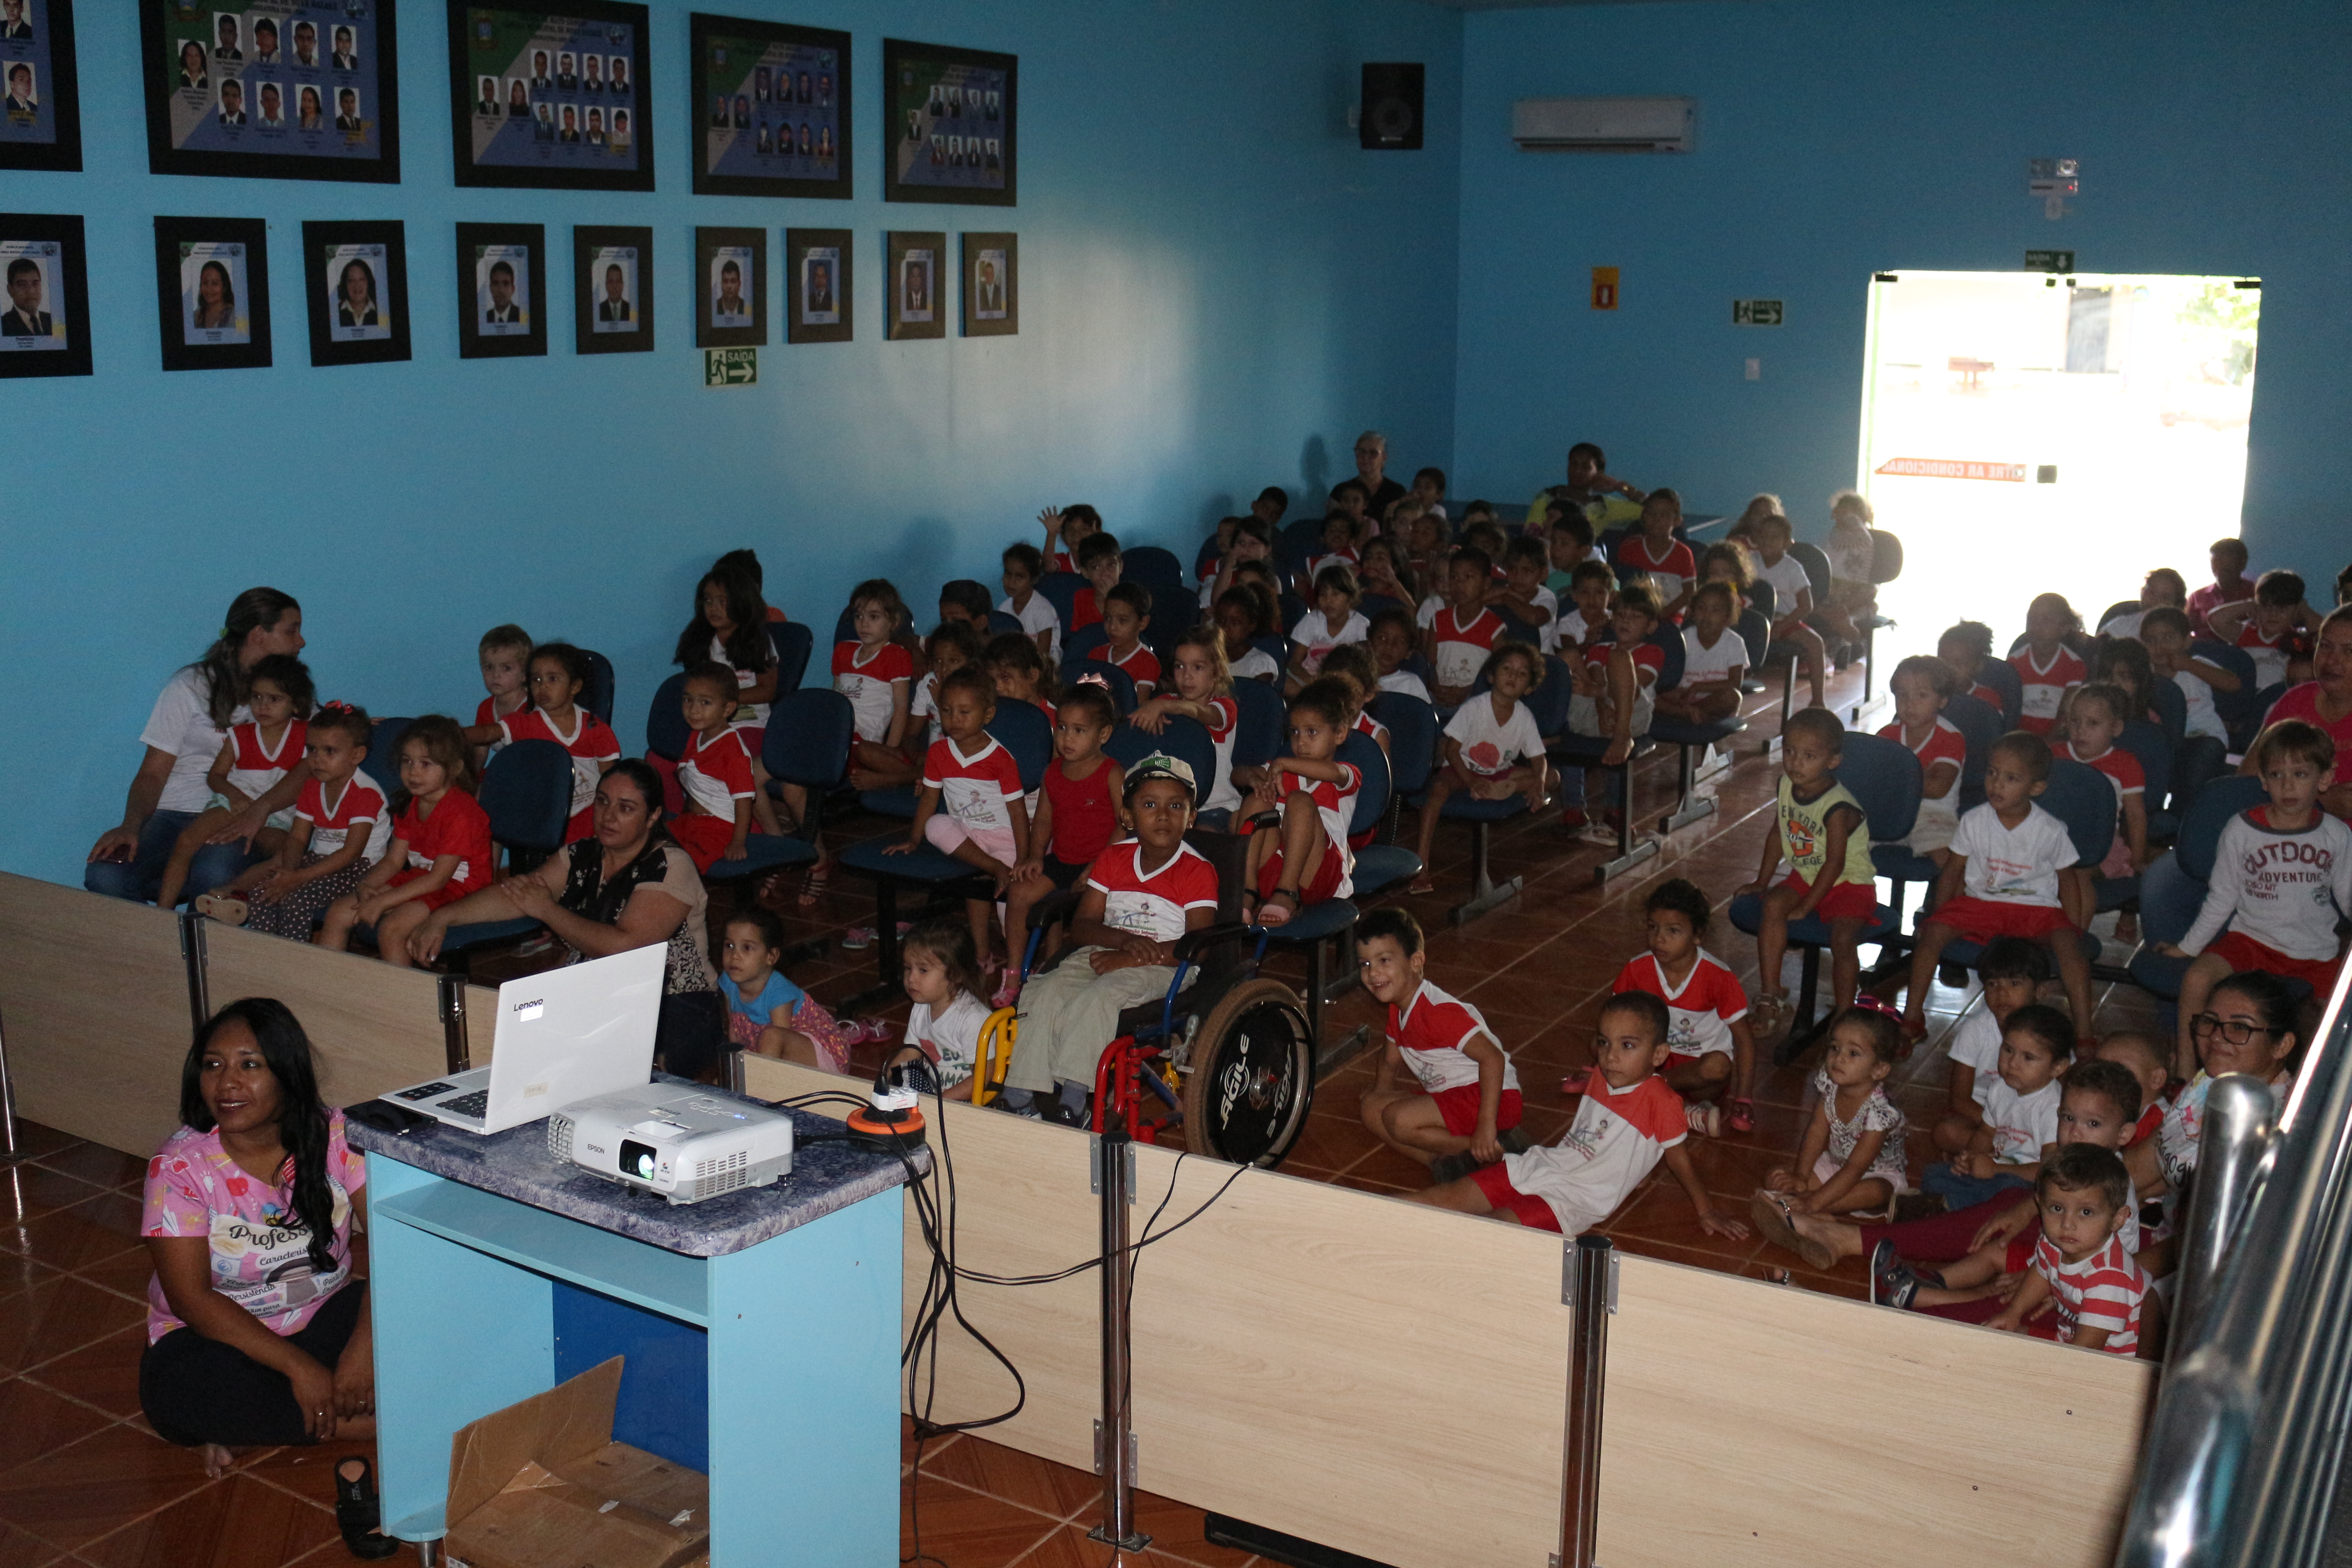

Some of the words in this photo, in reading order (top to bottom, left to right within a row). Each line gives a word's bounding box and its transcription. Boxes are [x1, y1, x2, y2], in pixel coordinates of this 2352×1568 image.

[514, 999, 543, 1012] Lenovo
[942, 1049, 960, 1061] EU
[1220, 1033, 1250, 1130] AGILE
[587, 1144, 605, 1154] EPSON
[229, 1225, 308, 1250] Profess
